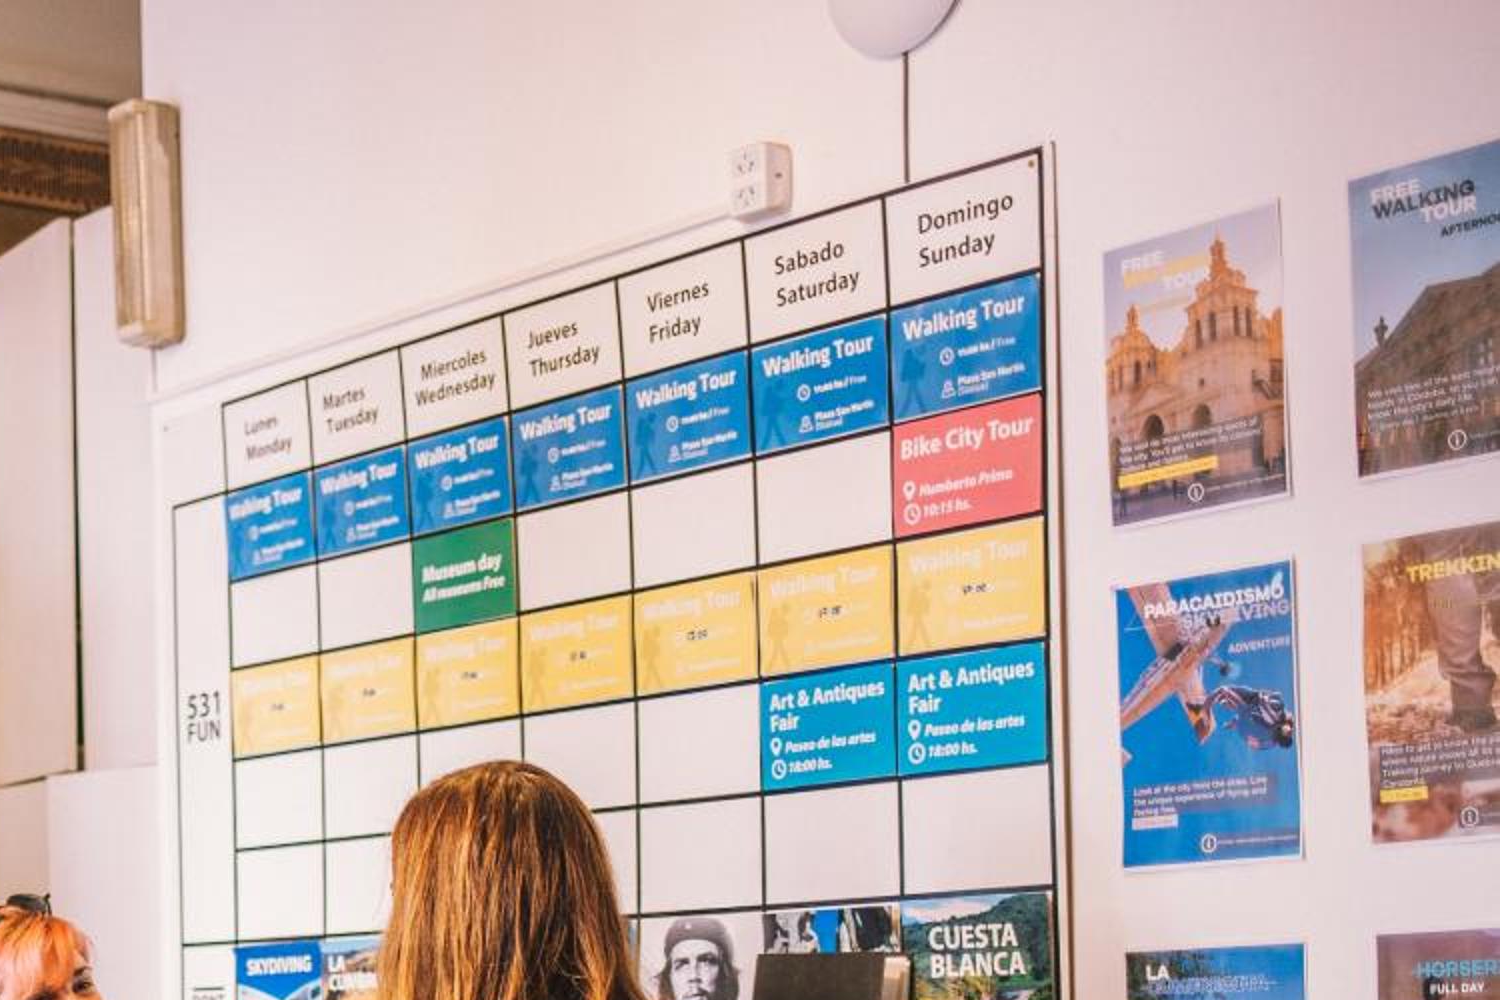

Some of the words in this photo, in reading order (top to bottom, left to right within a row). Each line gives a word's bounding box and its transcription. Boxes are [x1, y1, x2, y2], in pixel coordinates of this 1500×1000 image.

[1371, 180, 1421, 205] FREE
[1372, 180, 1475, 219] WALKING
[918, 193, 1014, 234] Domingo
[1420, 195, 1476, 223] TOUR
[774, 240, 845, 275] Sabado
[918, 230, 996, 268] Sunday
[647, 281, 710, 312] Viernes
[776, 269, 861, 307] Saturday
[648, 313, 701, 343] Friday
[902, 308, 978, 341] Walking
[980, 296, 1025, 320] Tour
[527, 321, 578, 349] Jueves
[420, 349, 487, 381] Miercoles
[529, 345, 600, 378] Thursday
[762, 347, 831, 377] Walking
[832, 335, 874, 359] Tour
[323, 386, 365, 411] Martes
[414, 373, 496, 407] Wednesday
[635, 381, 697, 409] Walking
[699, 370, 737, 391] Tour
[244, 415, 279, 436] Lunes
[326, 407, 379, 434] Tuesday
[519, 413, 576, 441] Walking
[577, 404, 613, 426] Tour
[246, 437, 293, 461] Monday
[414, 442, 468, 470] Walking
[468, 434, 499, 454] Tour
[901, 436, 942, 460] Bike
[945, 426, 984, 450] City
[987, 418, 1033, 441] Tour
[320, 468, 368, 495] Walking
[369, 461, 398, 480] Tour
[273, 487, 302, 505] Tour
[422, 560, 477, 584] Museum
[477, 552, 503, 573] day
[908, 673, 937, 693] Art
[939, 669, 953, 688] &
[956, 661, 1035, 687] Antiques
[187, 690, 221, 720] 531
[769, 693, 794, 712] Art
[797, 690, 810, 706] &
[813, 680, 885, 705] Antiques
[908, 695, 942, 714] Fair
[187, 720, 221, 744] FUN
[770, 713, 799, 733] Fair
[924, 722, 959, 737] Paseo
[960, 719, 975, 733] de
[996, 714, 1025, 728] artes
[817, 737, 830, 751] de
[847, 731, 876, 746] artes
[928, 744, 961, 758] 18:00
[929, 922, 1018, 952] CUESTA
[246, 955, 313, 977] SKYDIVING
[328, 955, 345, 973] LA
[930, 951, 1027, 980] BLANCA
[1145, 964, 1170, 981] LA
[1429, 983, 1459, 995] FULL
[1461, 981, 1485, 993] DAY
